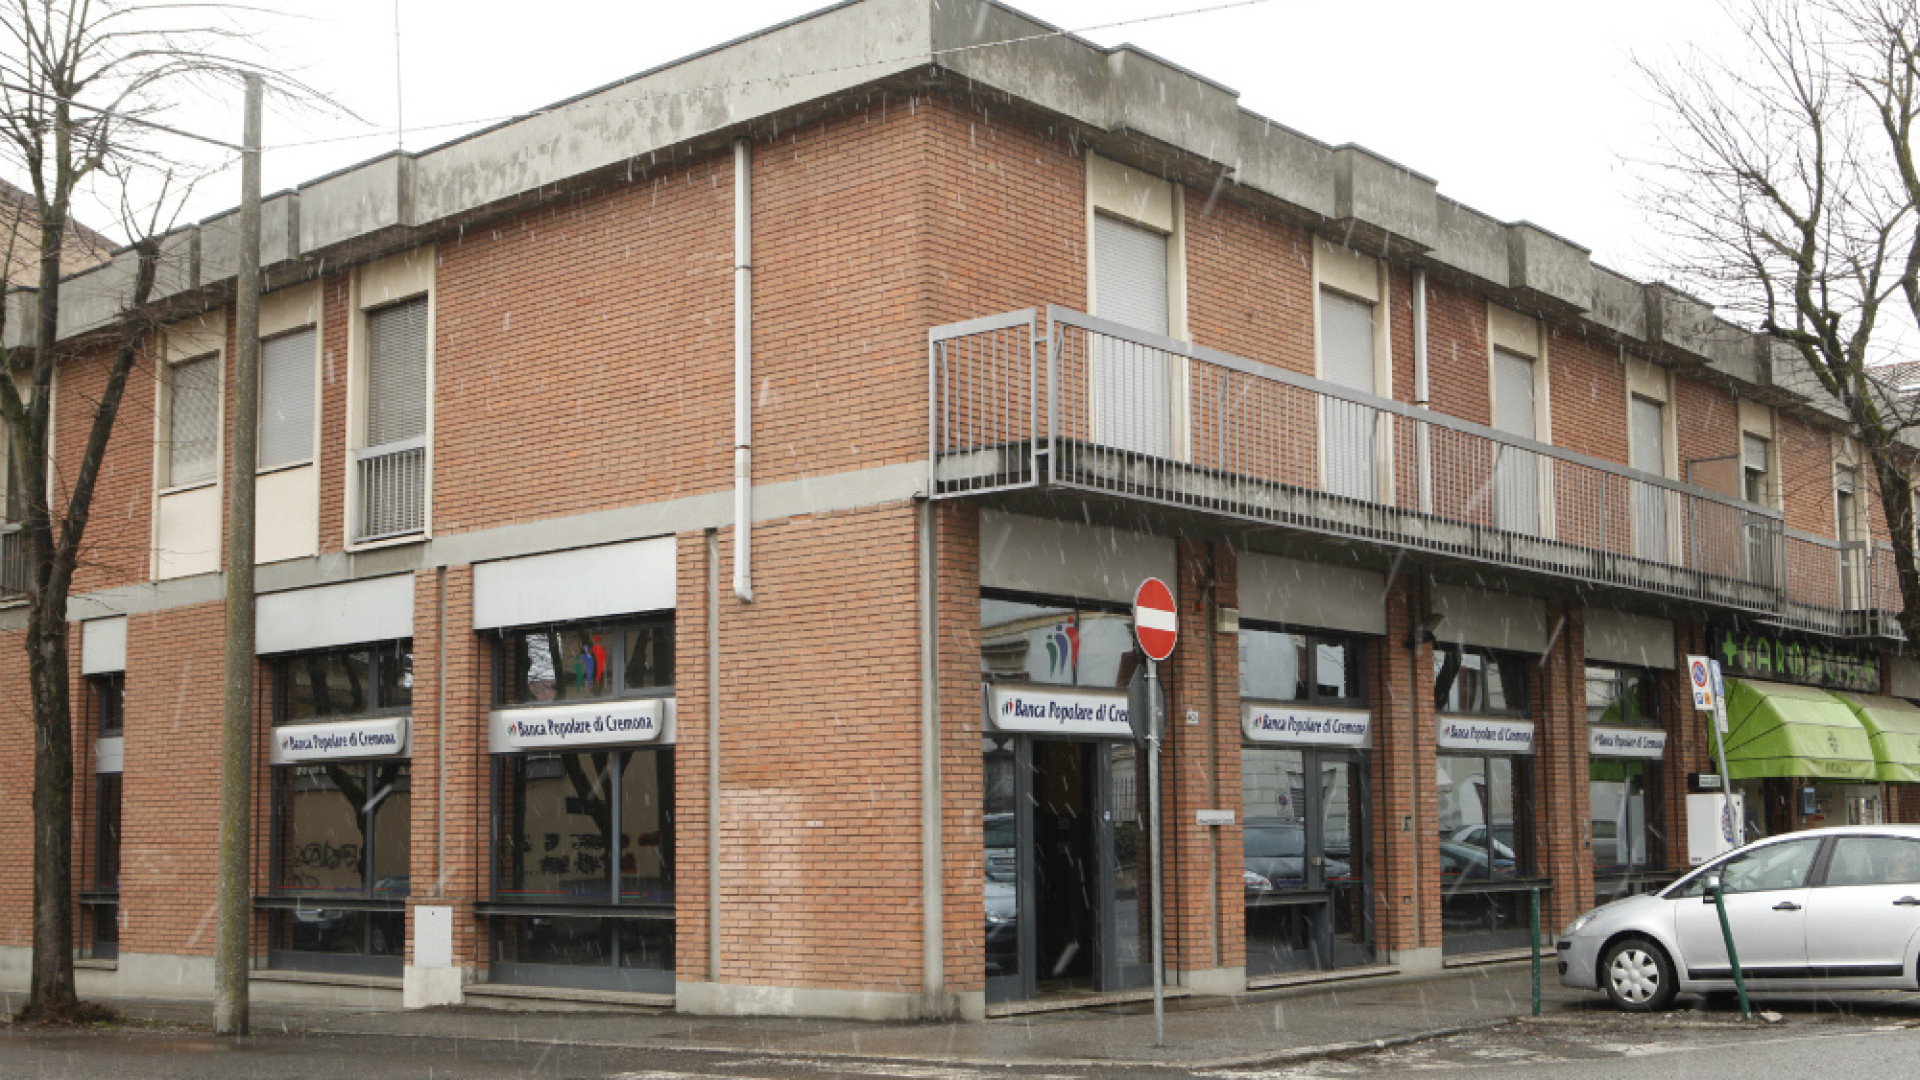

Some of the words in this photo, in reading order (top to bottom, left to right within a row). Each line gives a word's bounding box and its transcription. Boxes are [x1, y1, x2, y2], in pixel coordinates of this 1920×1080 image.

[1015, 698, 1045, 718] Banca
[1048, 700, 1093, 724] Popolare
[1096, 704, 1107, 721] di
[517, 720, 547, 738] Banca
[547, 718, 592, 739] Popolare
[593, 715, 604, 732] di
[605, 714, 654, 732] Cremona
[1262, 714, 1287, 731] Banca
[1288, 715, 1322, 736] Popolare
[1323, 719, 1332, 733] di
[1332, 719, 1366, 735] Cremona
[1451, 725, 1470, 739] Banca
[289, 736, 313, 750] Banca
[313, 733, 348, 752] Popolare
[349, 732, 358, 747] di
[358, 730, 396, 746] Cremona
